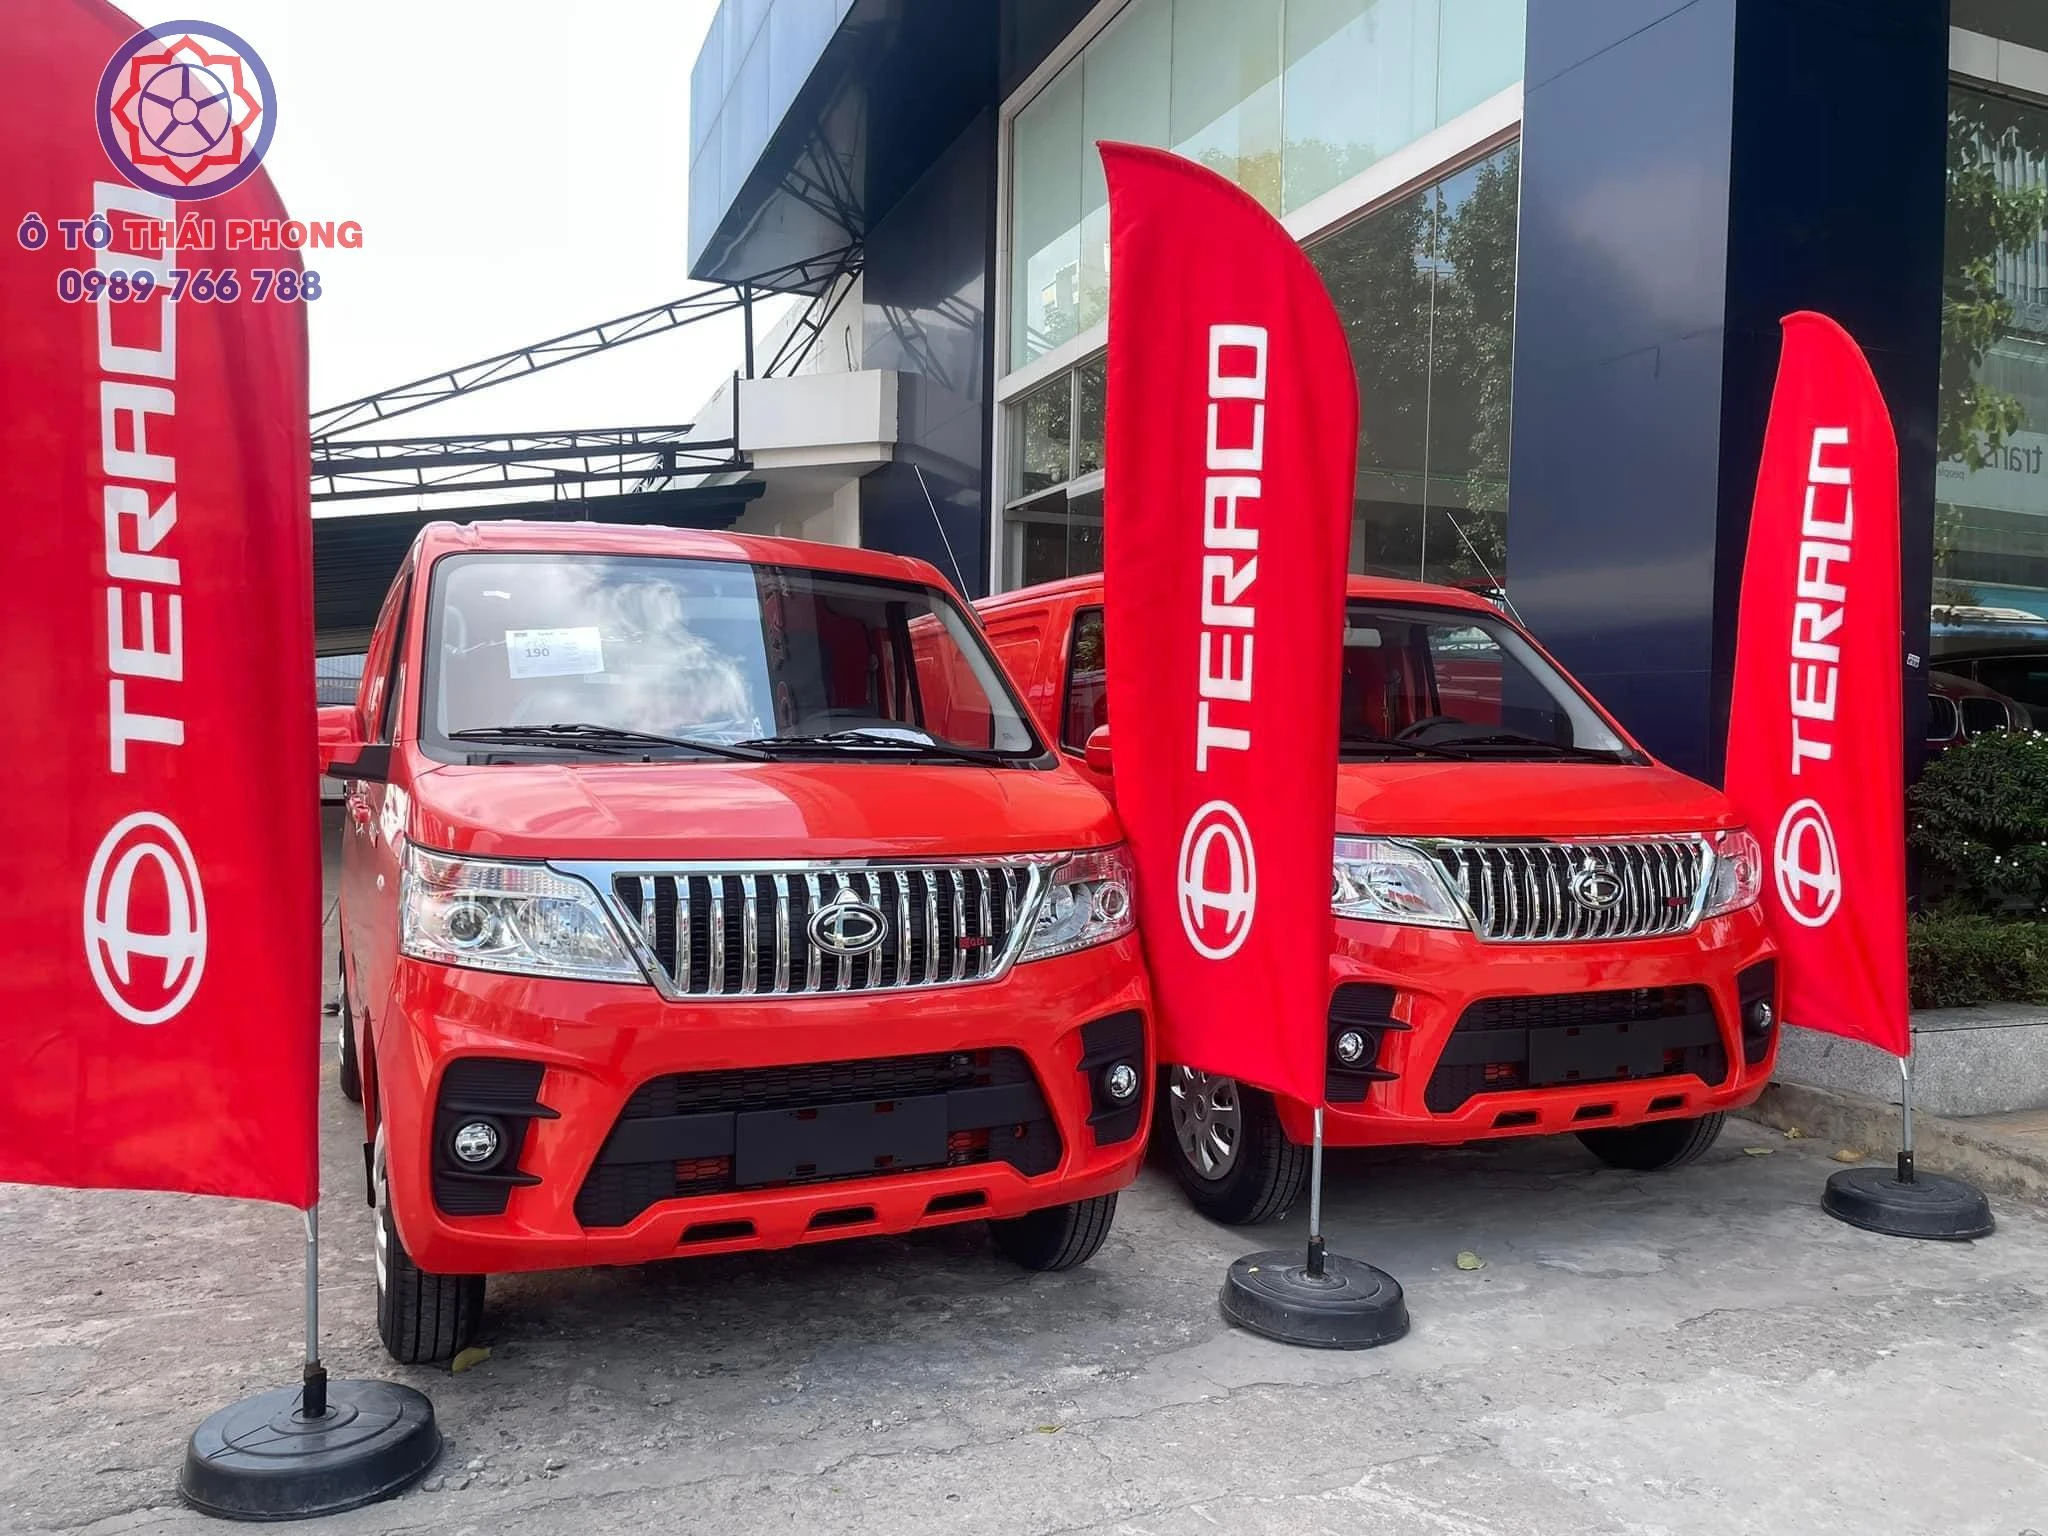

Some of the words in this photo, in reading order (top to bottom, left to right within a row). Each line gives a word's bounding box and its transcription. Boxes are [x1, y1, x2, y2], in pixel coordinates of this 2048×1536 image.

[93, 181, 185, 773] TERACO
[525, 647, 551, 658] 190
[1196, 323, 1268, 772] TERACO
